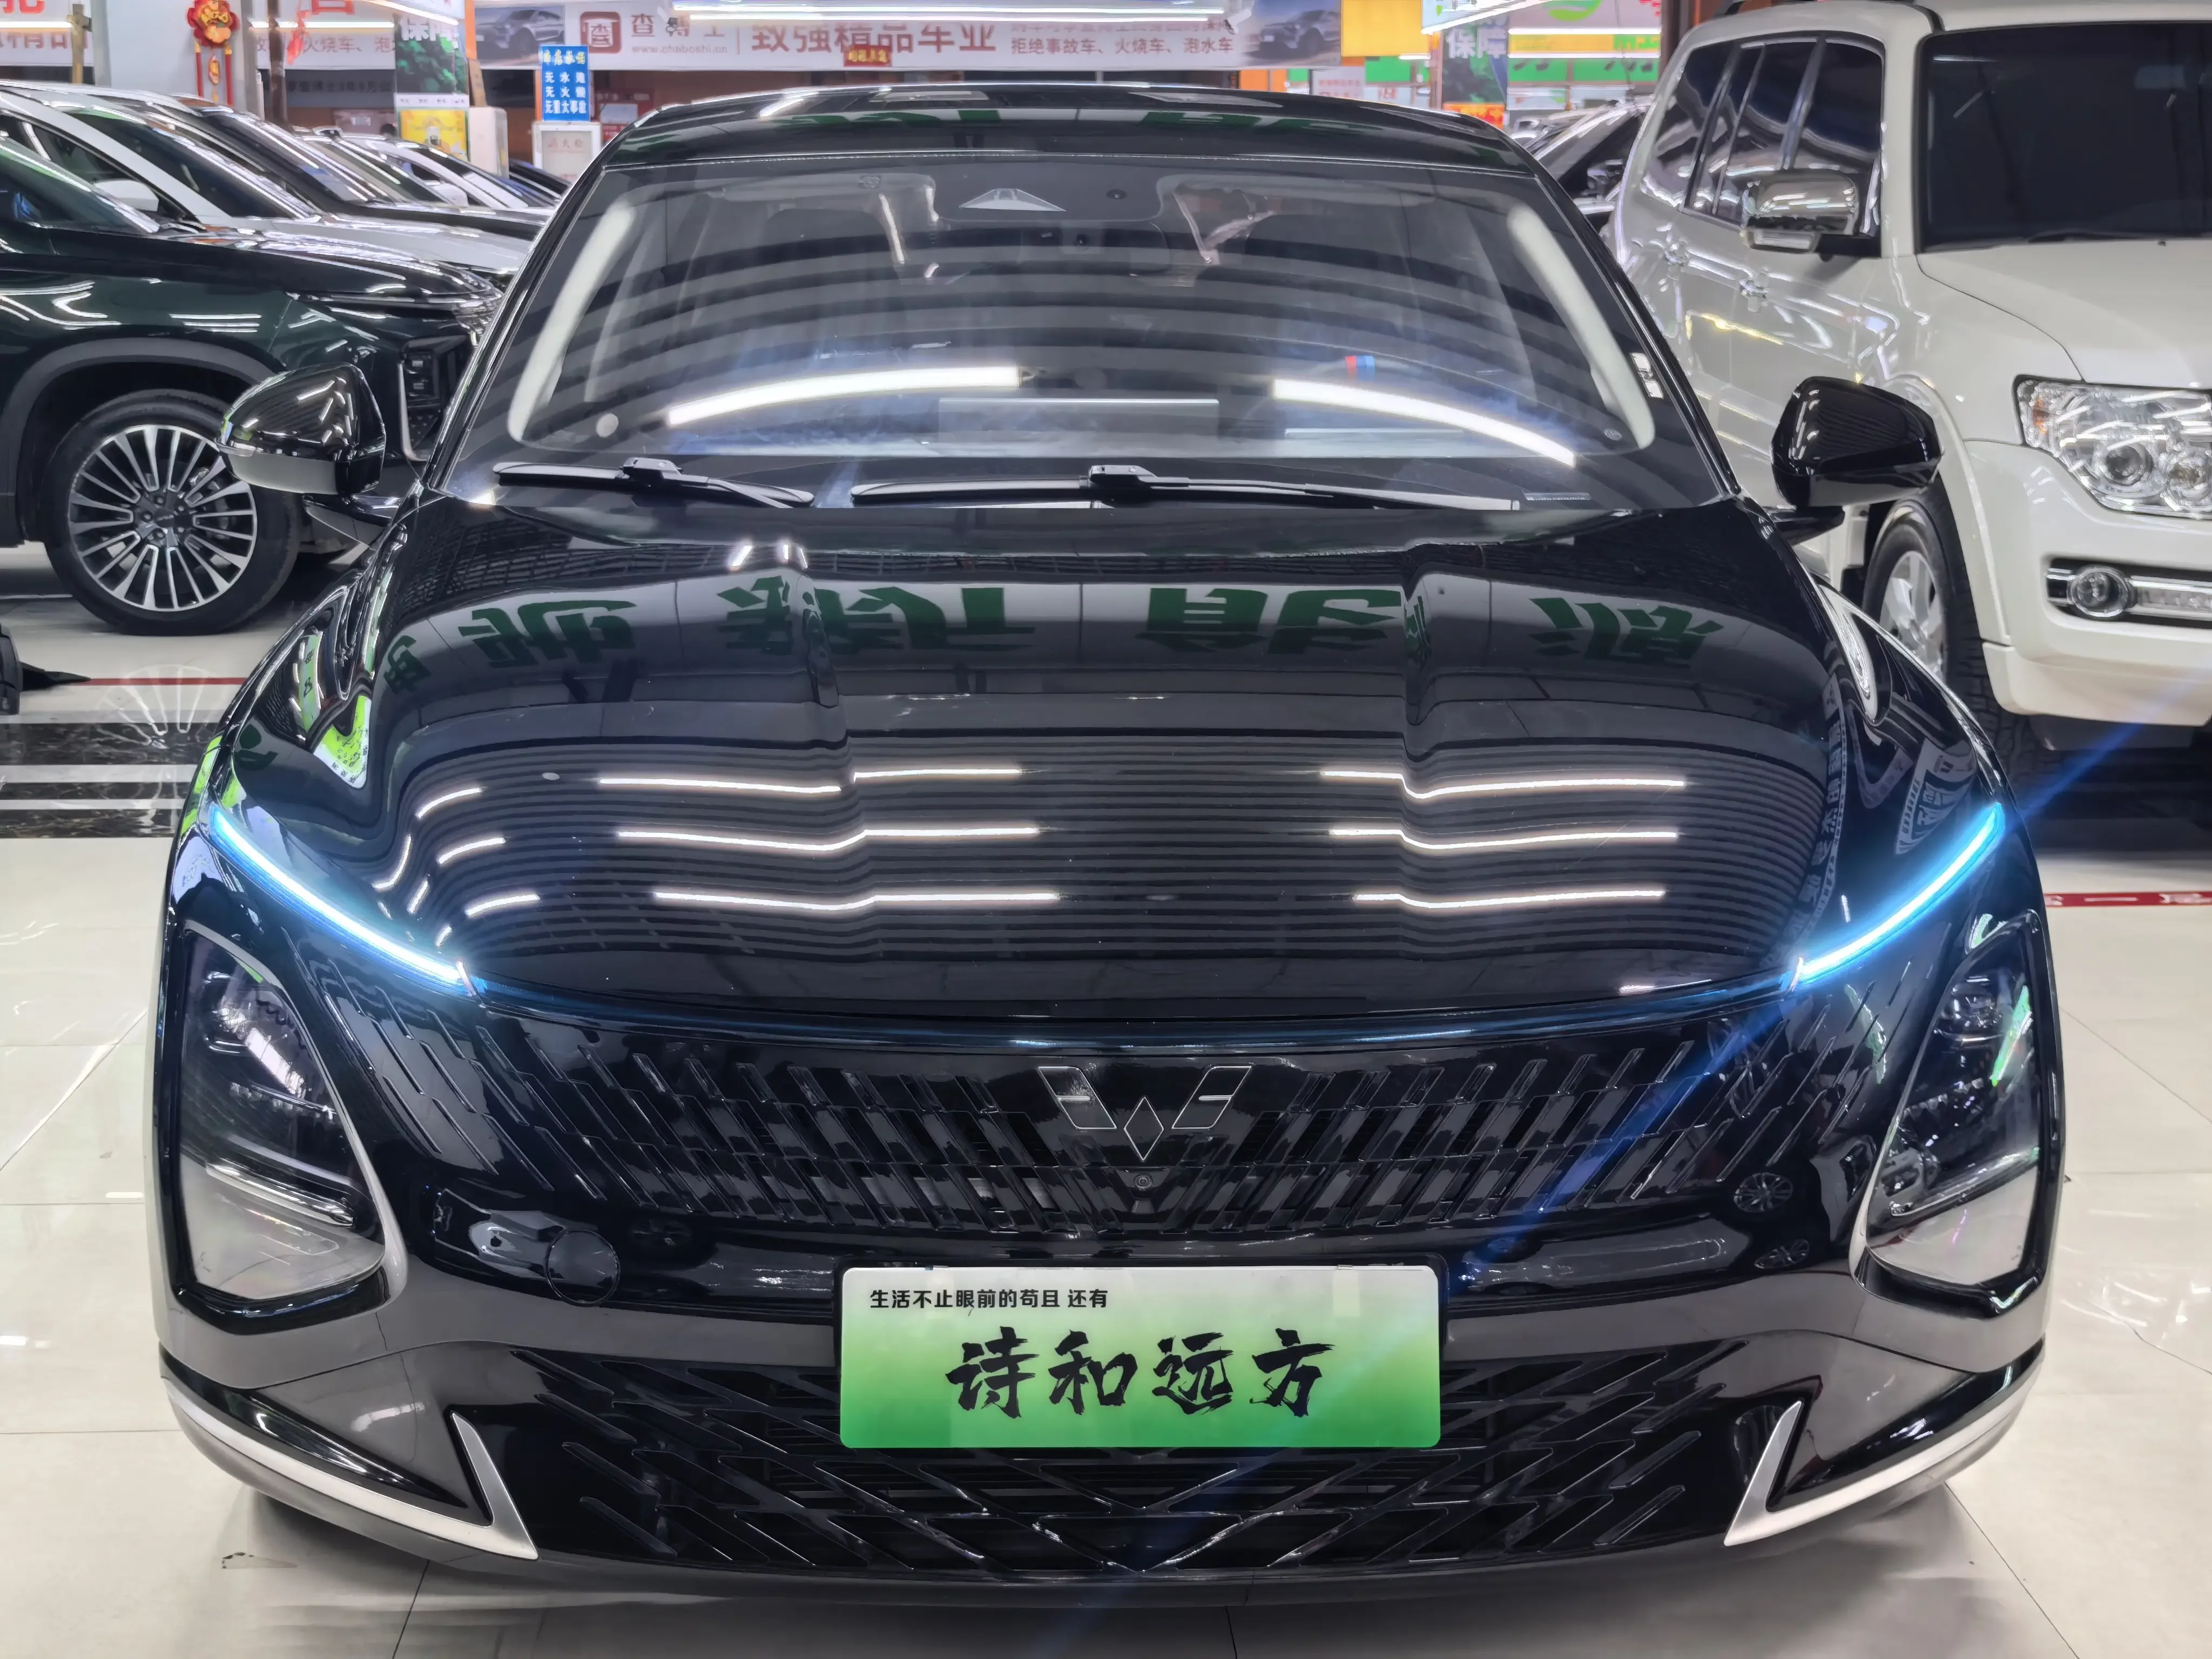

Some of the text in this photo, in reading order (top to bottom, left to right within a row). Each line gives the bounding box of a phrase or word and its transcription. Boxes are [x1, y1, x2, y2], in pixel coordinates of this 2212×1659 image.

[869, 1289, 1109, 1309] 生活不止眼前的苟且 还有
[945, 1325, 1337, 1419] 诗和远方
